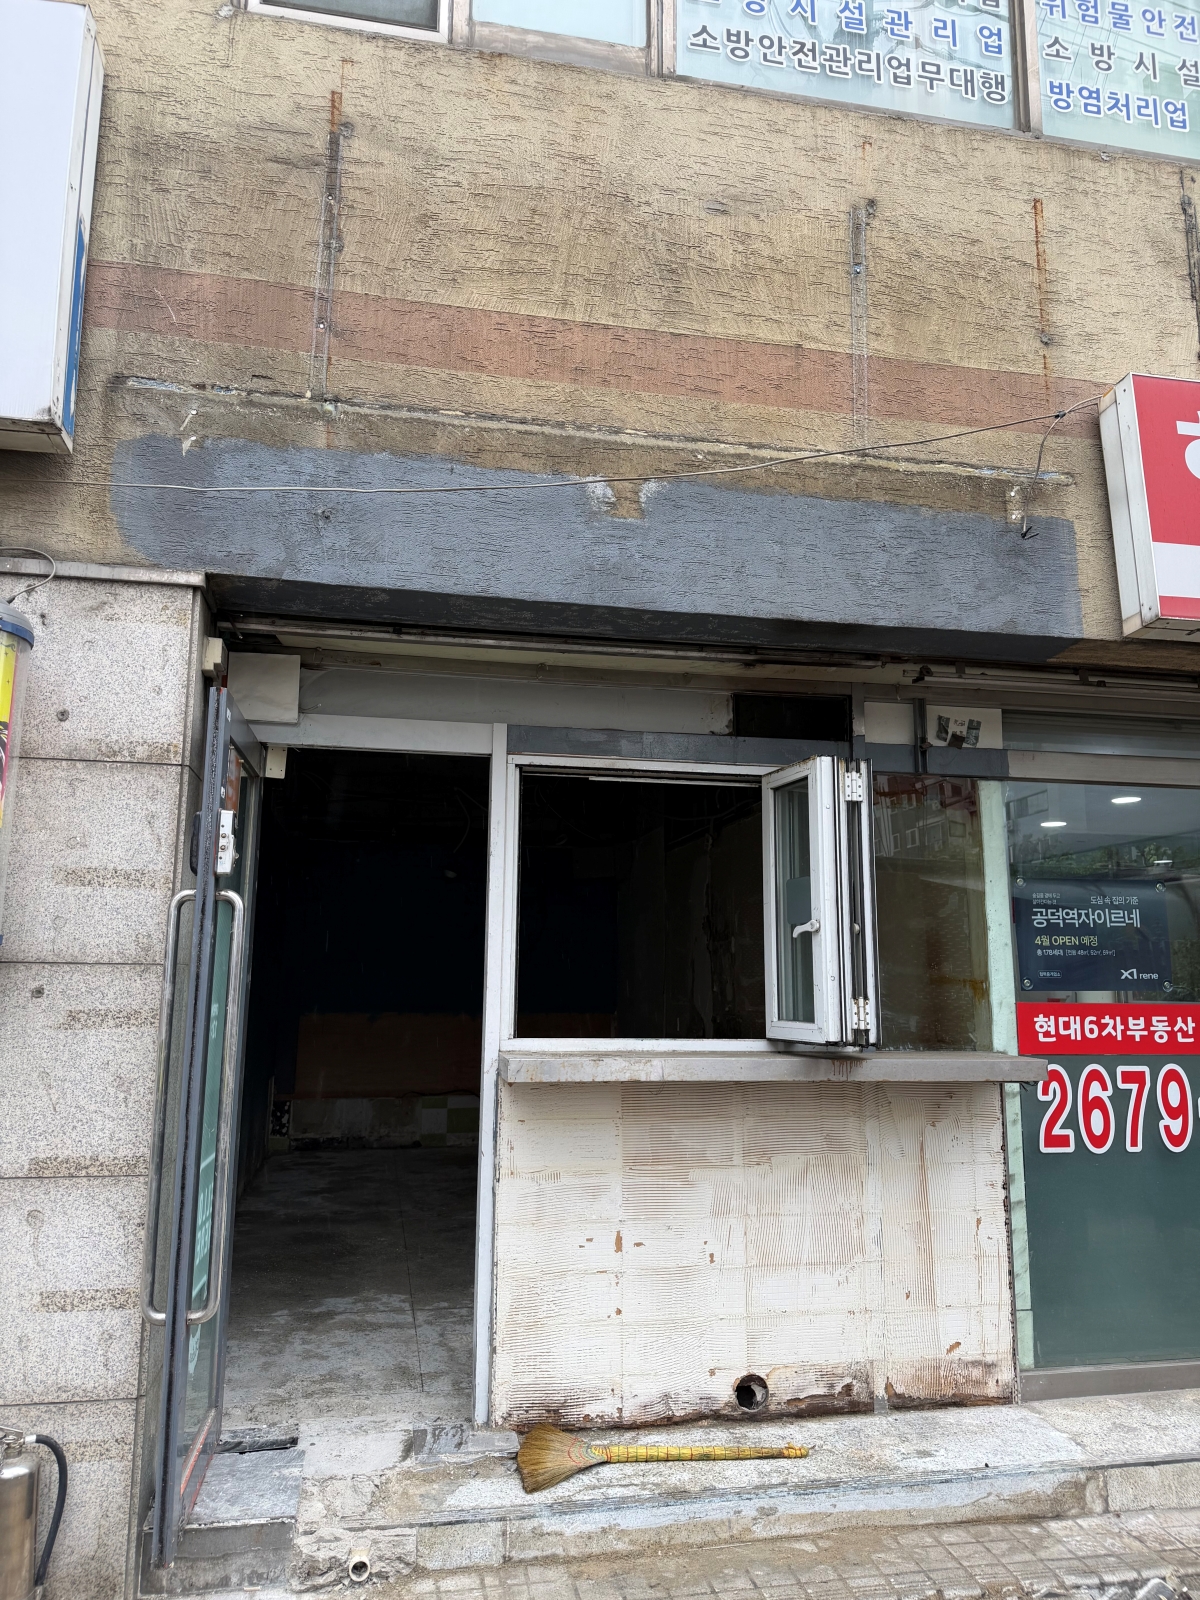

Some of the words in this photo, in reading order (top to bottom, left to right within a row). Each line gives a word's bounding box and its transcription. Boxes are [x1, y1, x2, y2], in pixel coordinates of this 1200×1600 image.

[688, 24, 1007, 102] 소방안전관리업무대행
[1048, 80, 1188, 130] 방염처리업
[1090, 896, 1103, 905] 도심
[1104, 896, 1111, 905] 속
[1112, 896, 1125, 905] 집의
[1126, 896, 1139, 905] 기준
[1031, 907, 1141, 928] 공덕역자이르네
[1034, 935, 1050, 946] 4월
[1051, 935, 1079, 946] OPEN
[1080, 935, 1098, 947] 예정
[1033, 1014, 1196, 1044] 현대6차부동산
